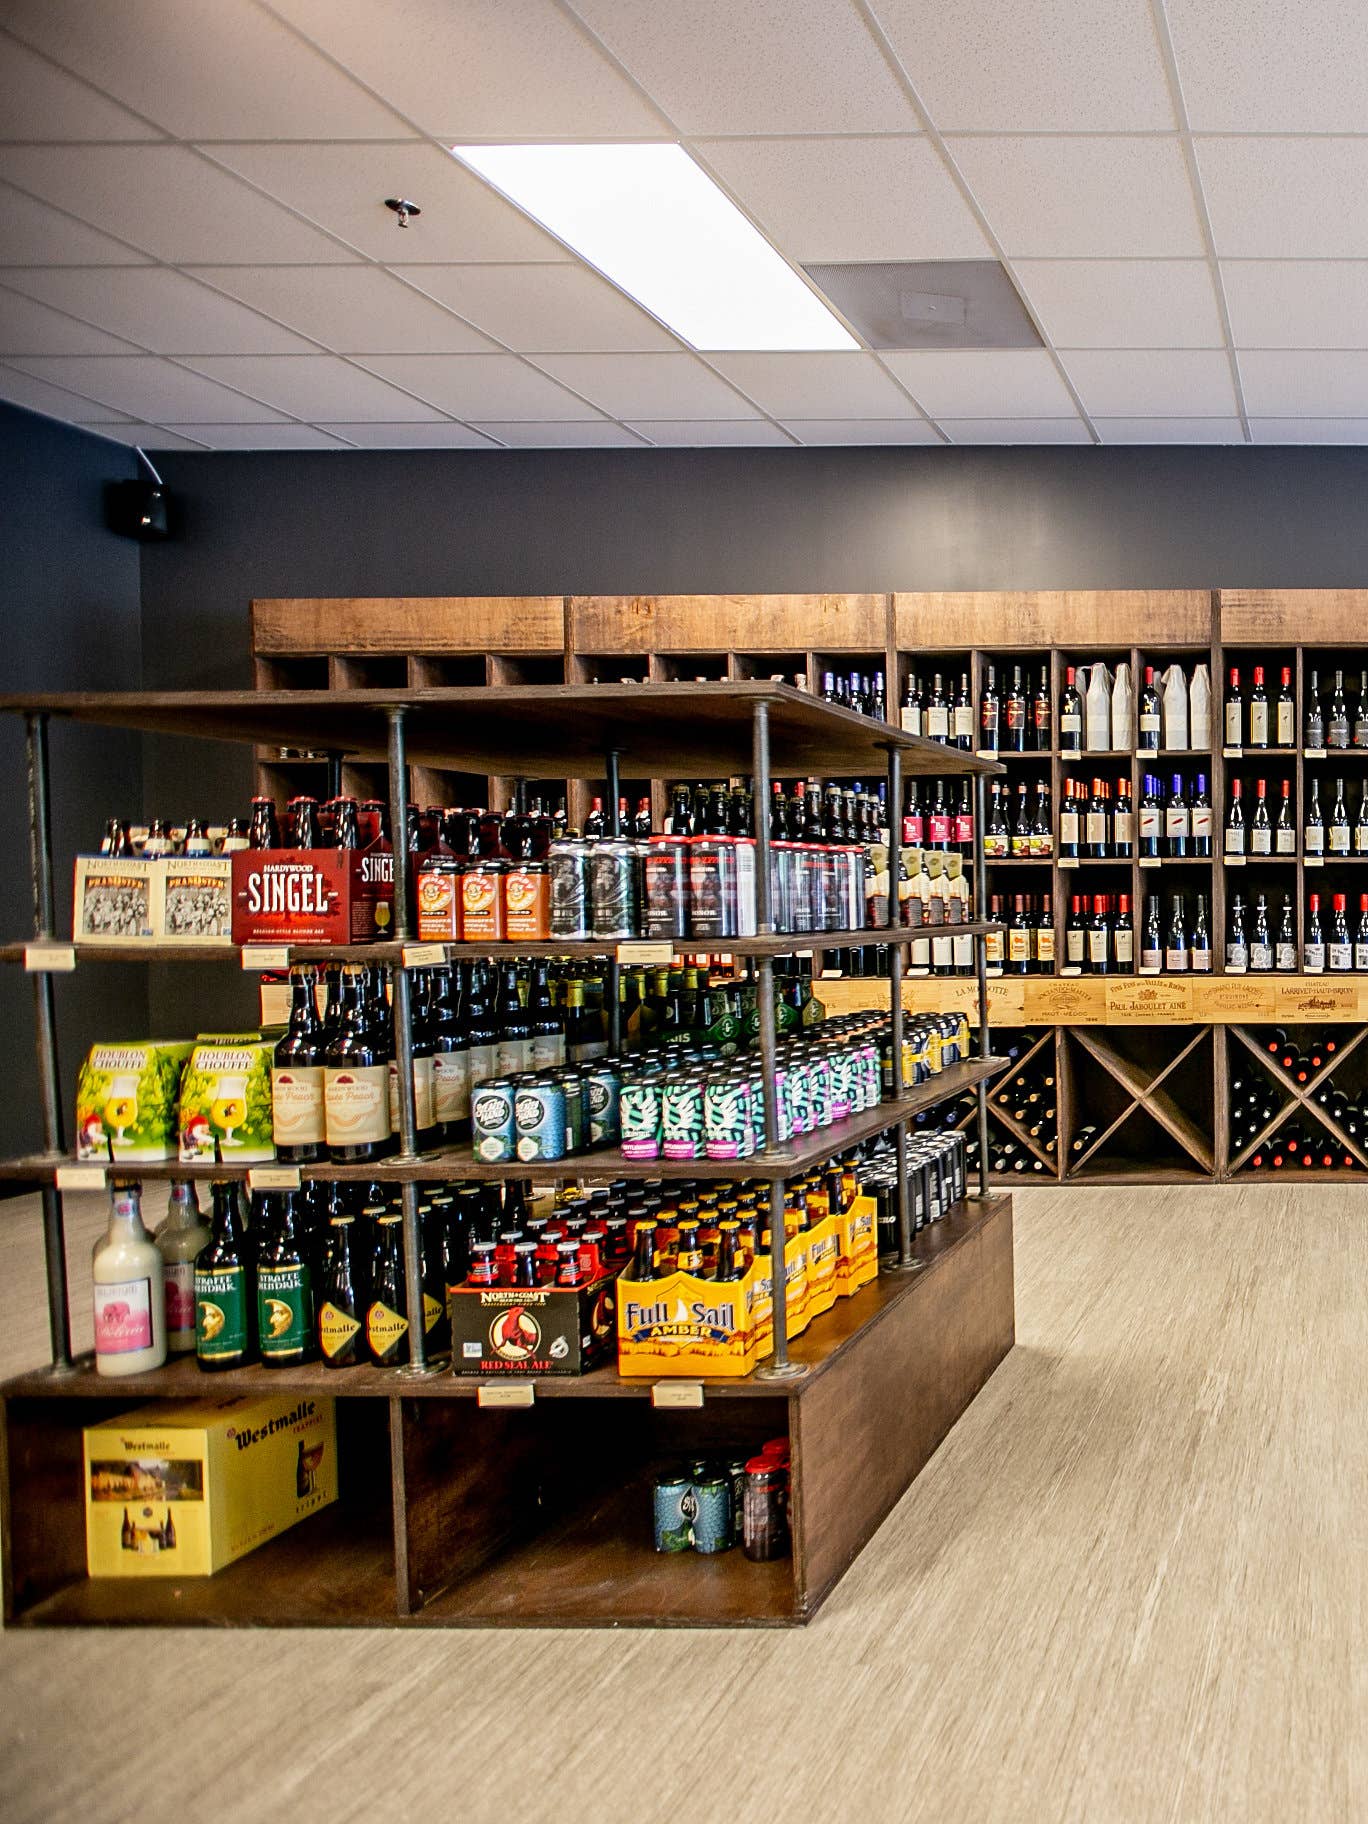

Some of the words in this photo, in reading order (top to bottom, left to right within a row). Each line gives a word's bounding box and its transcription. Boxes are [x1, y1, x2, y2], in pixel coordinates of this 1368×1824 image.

[263, 865, 314, 873] HARDYWOOD
[361, 857, 395, 883] SINGE
[248, 873, 328, 912] SINGEL
[1110, 1001, 1128, 1010] PAUL
[1129, 1001, 1167, 1010] JABOULET
[95, 1050, 146, 1059] HOUBLON
[197, 1051, 253, 1060] HOUBLON
[93, 1060, 146, 1069] CHOUFFE
[195, 1061, 251, 1069] CHOUFFE
[481, 1292, 515, 1303] NORTH
[518, 1292, 550, 1303] COAST
[625, 1303, 669, 1330] Full
[691, 1303, 735, 1331] Sail
[650, 1324, 712, 1338] AMBER
[480, 1361, 502, 1370] RED
[504, 1361, 530, 1370] SEAL
[531, 1361, 553, 1370] ALE
[235, 1400, 317, 1450] Westmalle
[124, 1441, 171, 1451] Westmalle
